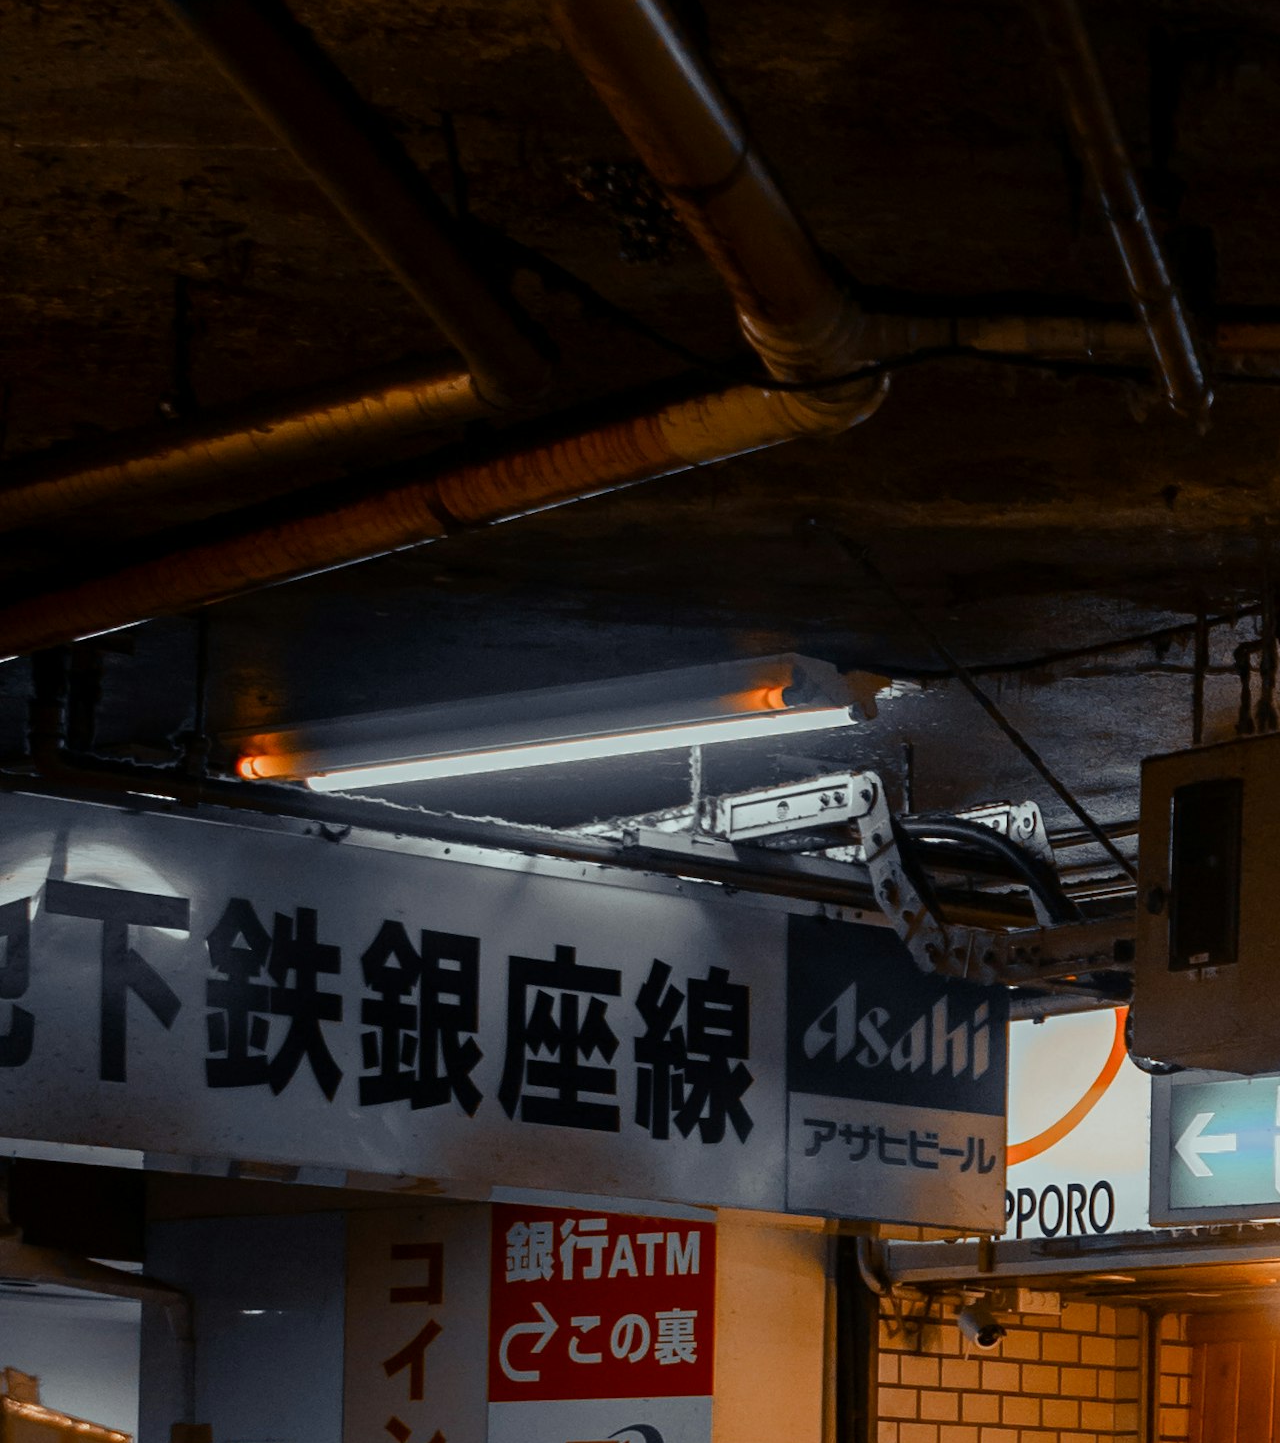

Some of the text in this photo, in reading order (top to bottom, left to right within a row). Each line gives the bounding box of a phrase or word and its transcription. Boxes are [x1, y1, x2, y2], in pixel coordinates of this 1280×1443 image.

[802, 981, 990, 1082] Asahi
[803, 1117, 996, 1175] アサヒビール
[504, 1218, 701, 1285] 銀行ATM
[567, 1307, 699, 1367] この裏
